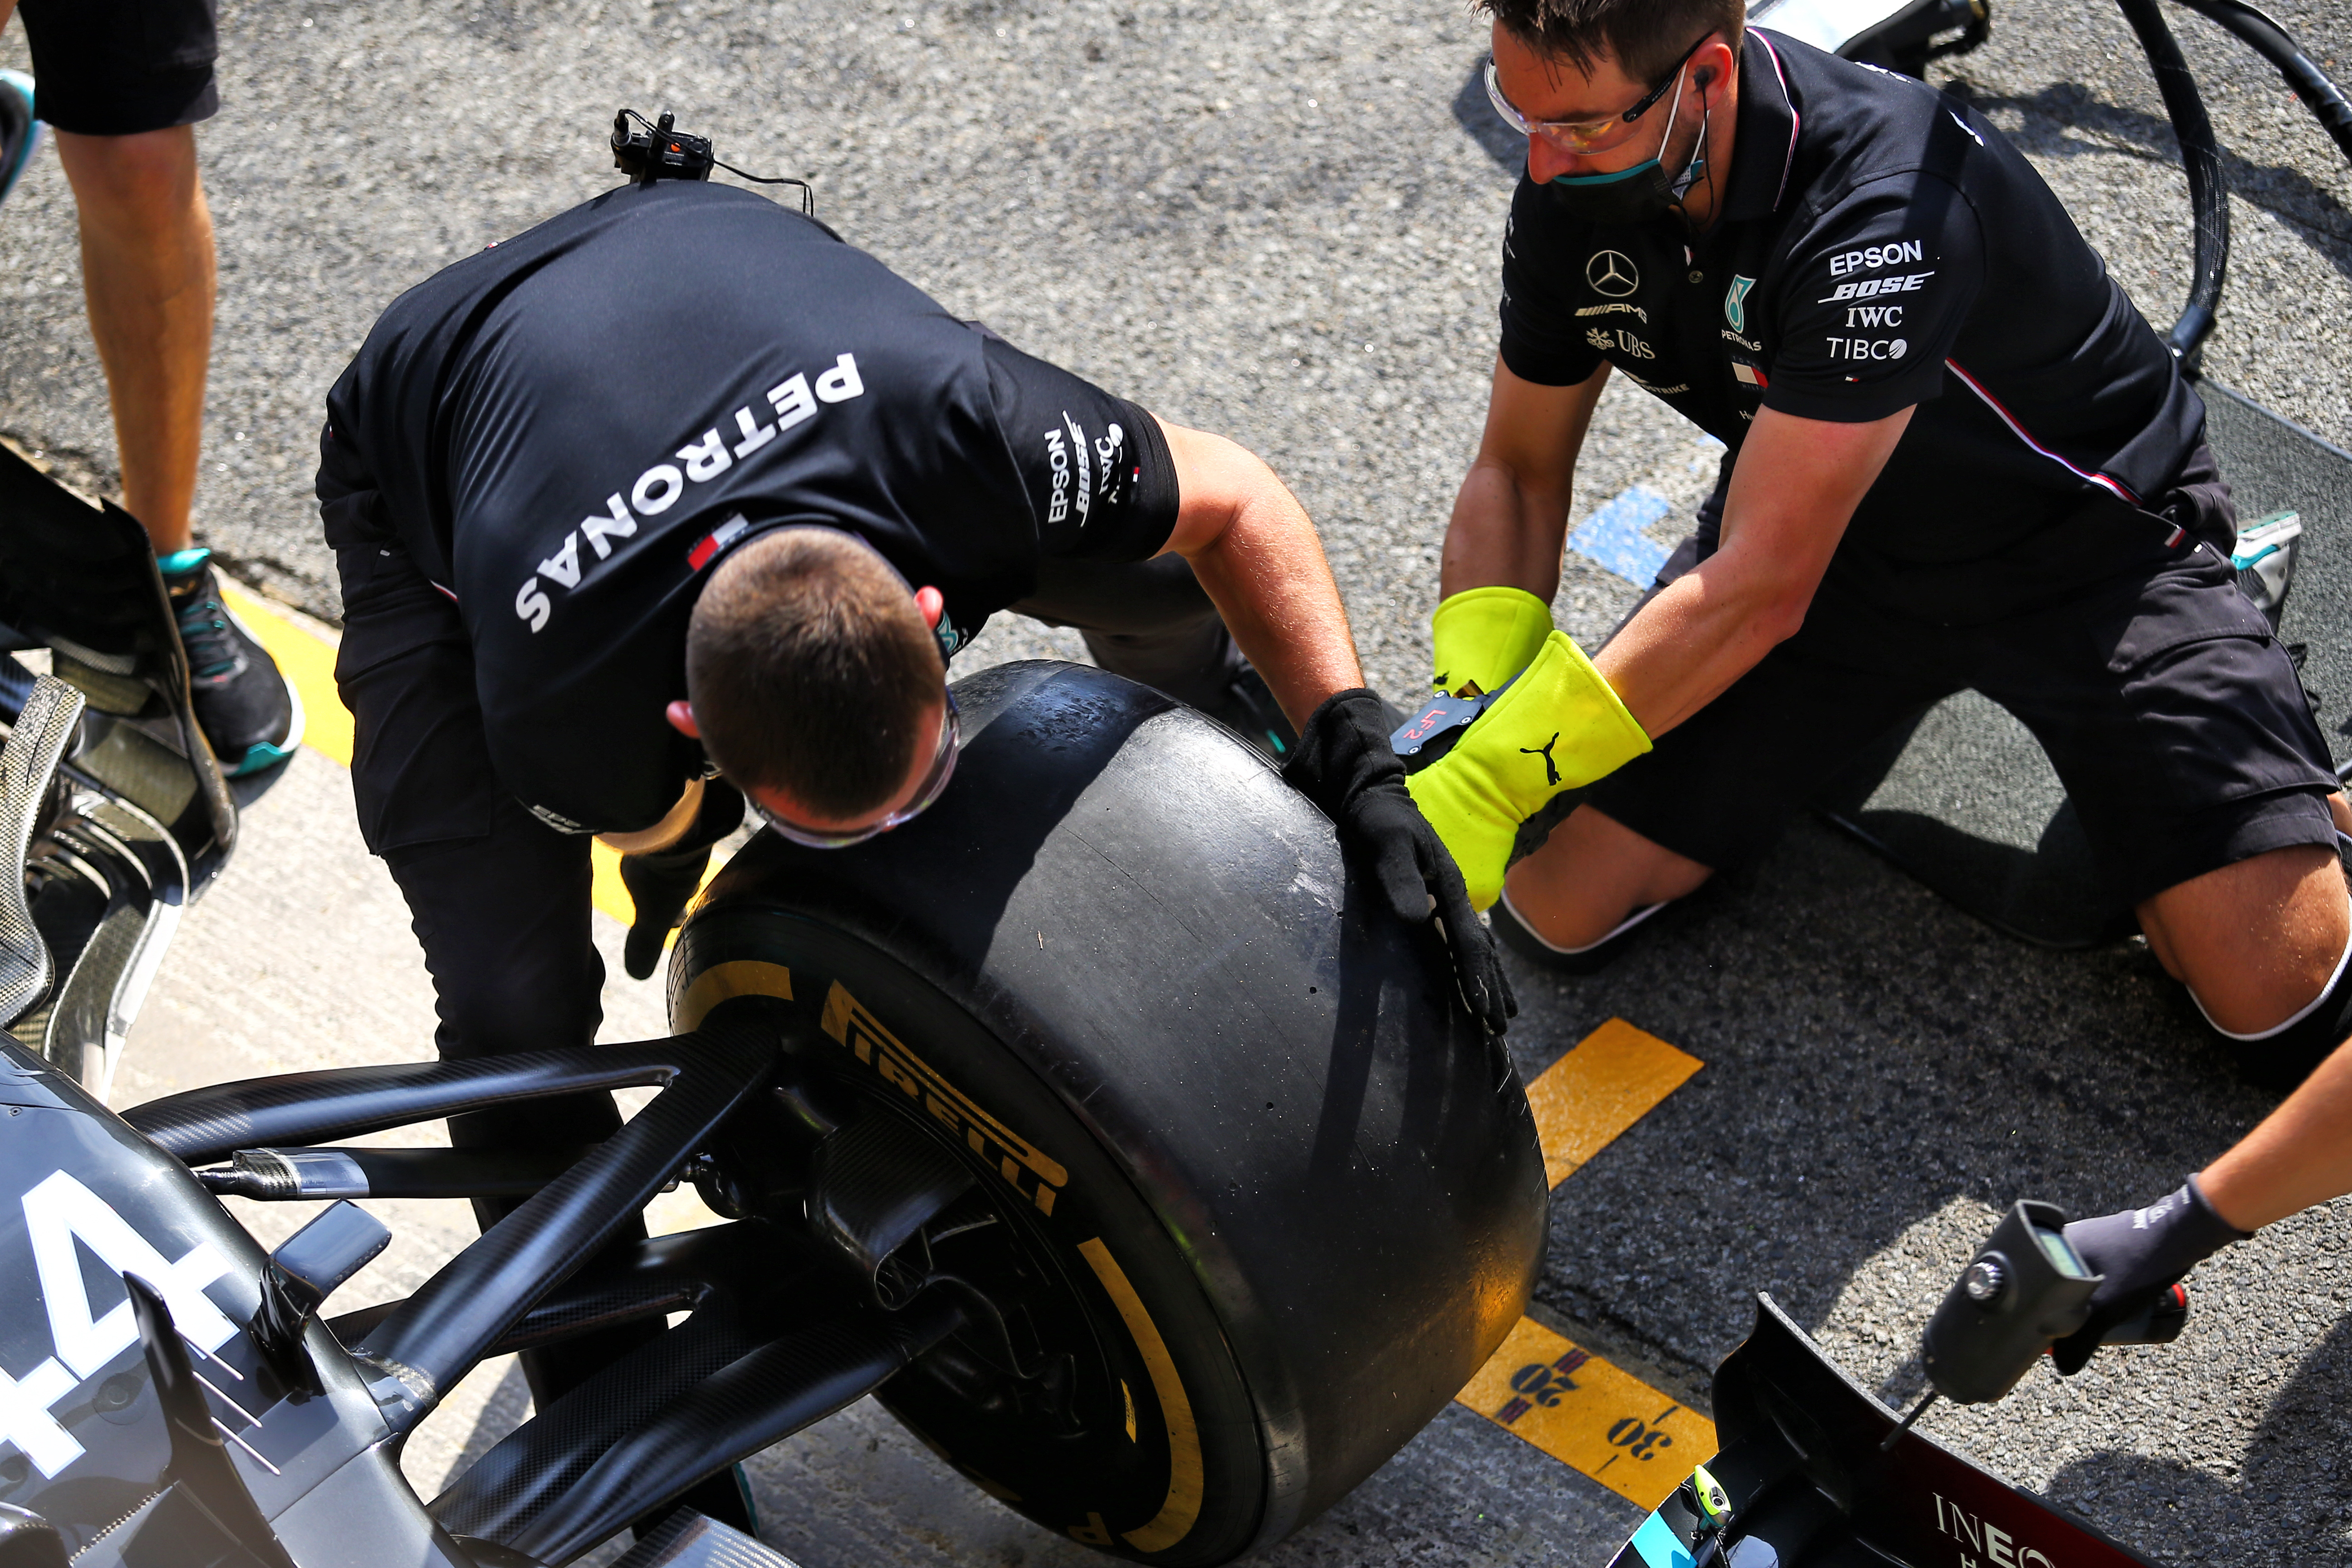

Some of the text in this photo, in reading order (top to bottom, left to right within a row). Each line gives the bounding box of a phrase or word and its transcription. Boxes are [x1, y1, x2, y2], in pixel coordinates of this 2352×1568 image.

[1830, 240, 1922, 276] EPSON
[1818, 271, 1935, 304] BOSE
[1845, 306, 1902, 328] IWC
[1616, 329, 1656, 359] UBS
[1721, 329, 1762, 351] PETRONAS
[1827, 337, 1907, 360] TIBCO
[1044, 428, 1070, 523] EPSON
[1062, 410, 1090, 527] BOSE
[515, 353, 864, 633] PETRONAS
[1402, 709, 1447, 740] LF2
[821, 979, 1068, 1217] PIRELLI
[1510, 1364, 1581, 1407] 20
[1607, 1418, 1672, 1461] 30
